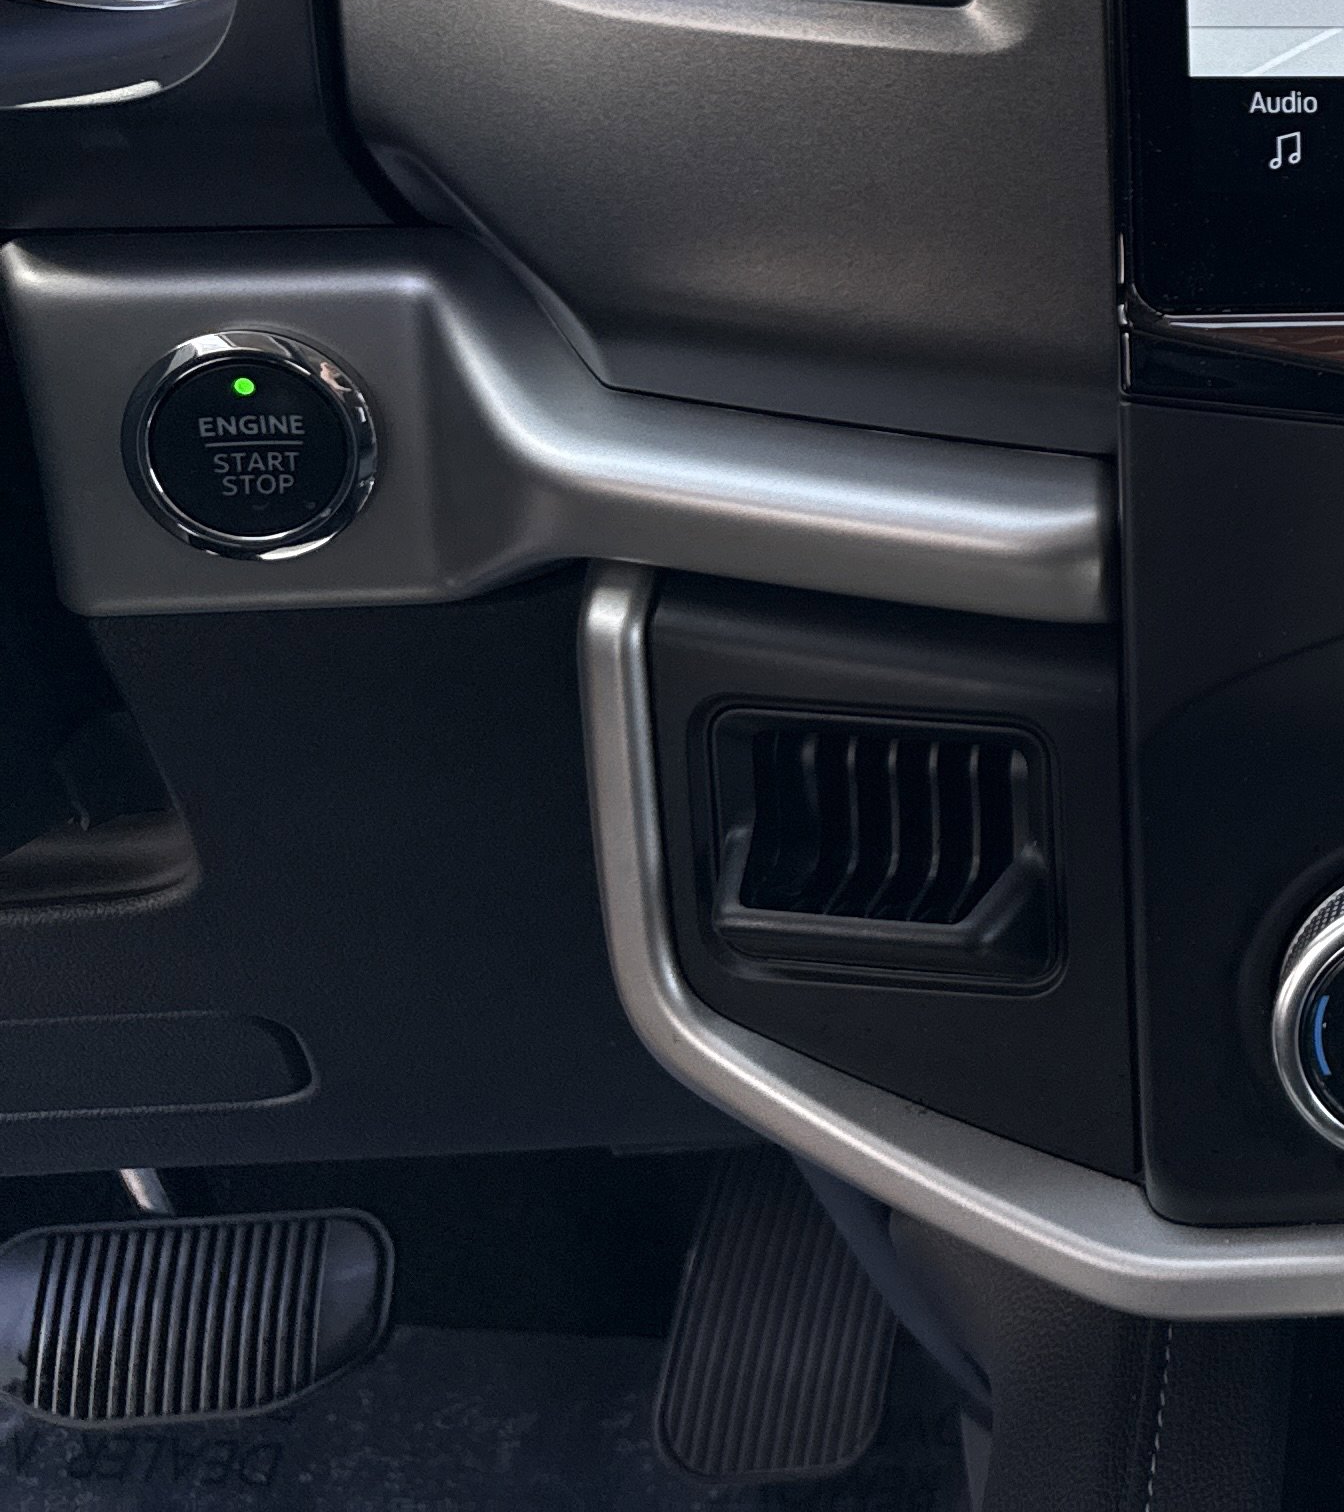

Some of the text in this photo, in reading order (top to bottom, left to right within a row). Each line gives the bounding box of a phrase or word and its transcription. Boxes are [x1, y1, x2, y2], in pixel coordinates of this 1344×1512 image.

[1248, 90, 1319, 114] Audio
[197, 414, 306, 438] ENGINE
[212, 450, 300, 474] START
[221, 474, 295, 497] STOP
